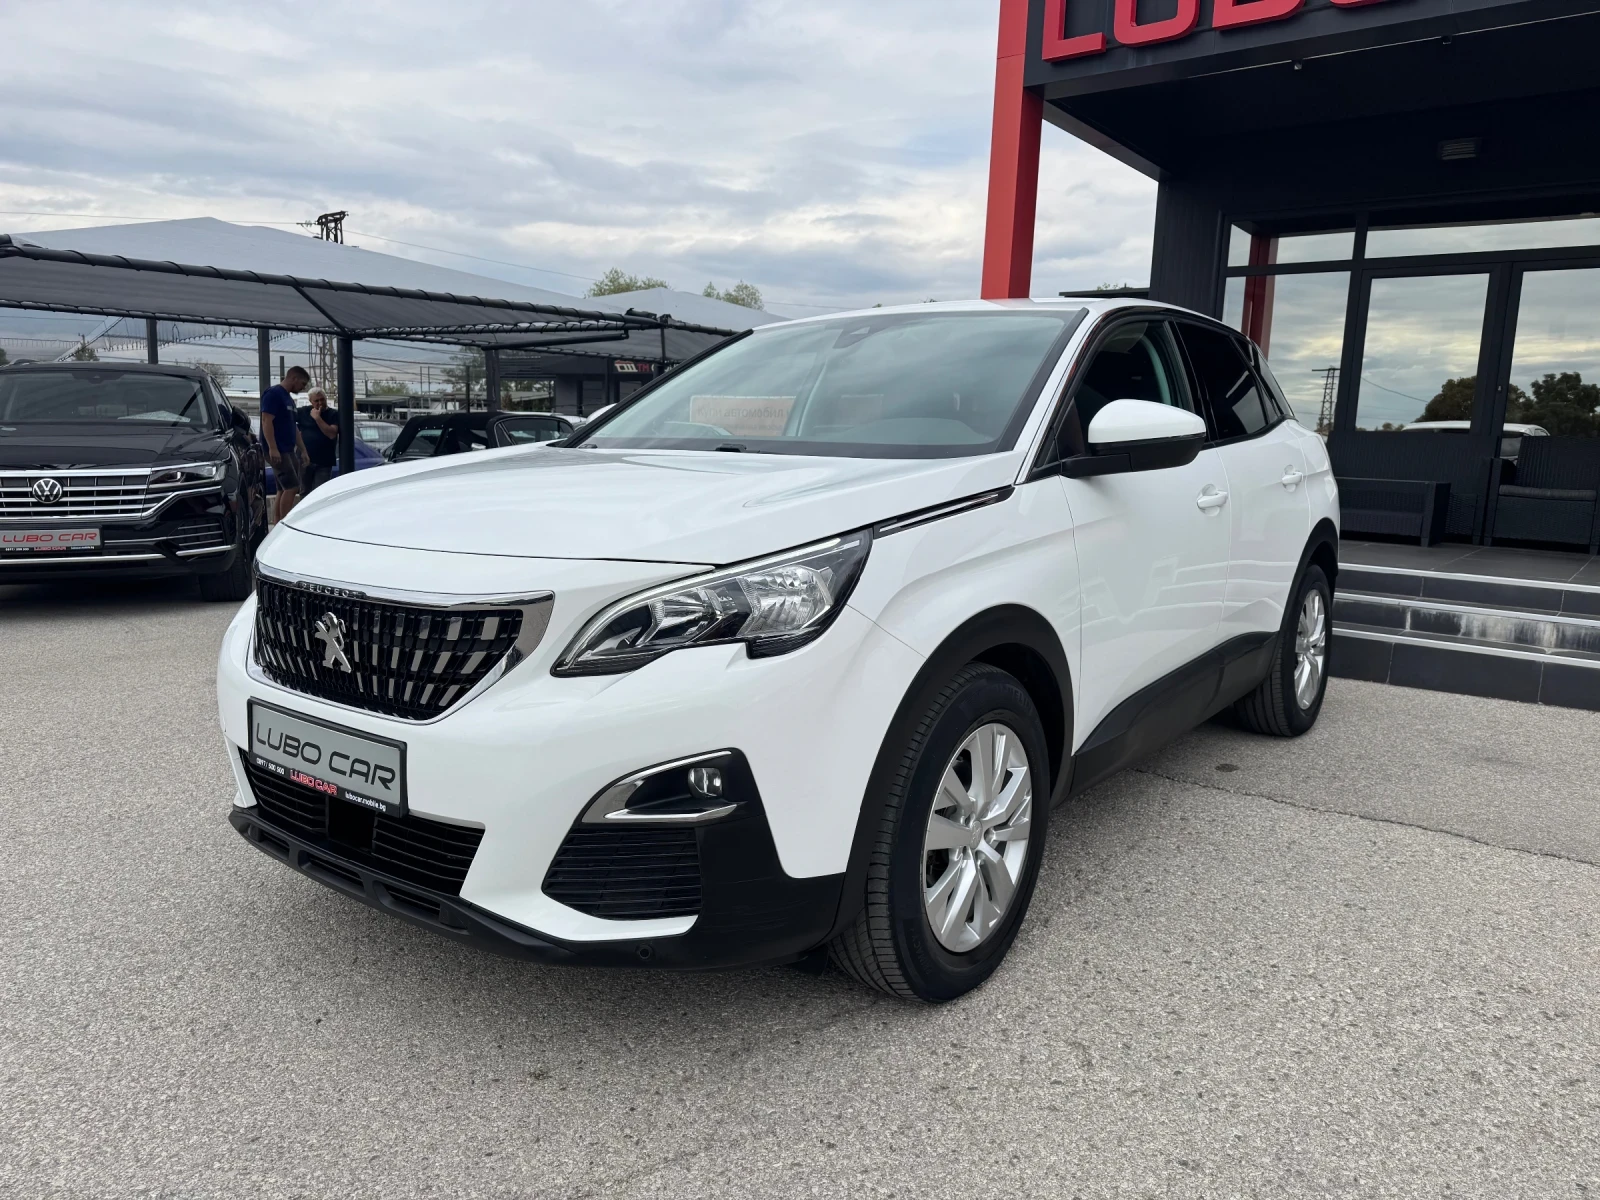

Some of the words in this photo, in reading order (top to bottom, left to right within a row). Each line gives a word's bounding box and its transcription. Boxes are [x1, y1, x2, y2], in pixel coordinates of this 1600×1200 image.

[1041, 0, 1382, 63] LU
[724, 406, 783, 418] автомобил
[2, 534, 54, 543] LUBO
[58, 532, 97, 542] CAR
[256, 723, 322, 765] LUBO
[328, 751, 396, 791] CAR
[290, 769, 315, 788] LUBO
[315, 779, 338, 796] CAR
[345, 790, 387, 813] lubocar.mobile.bg
